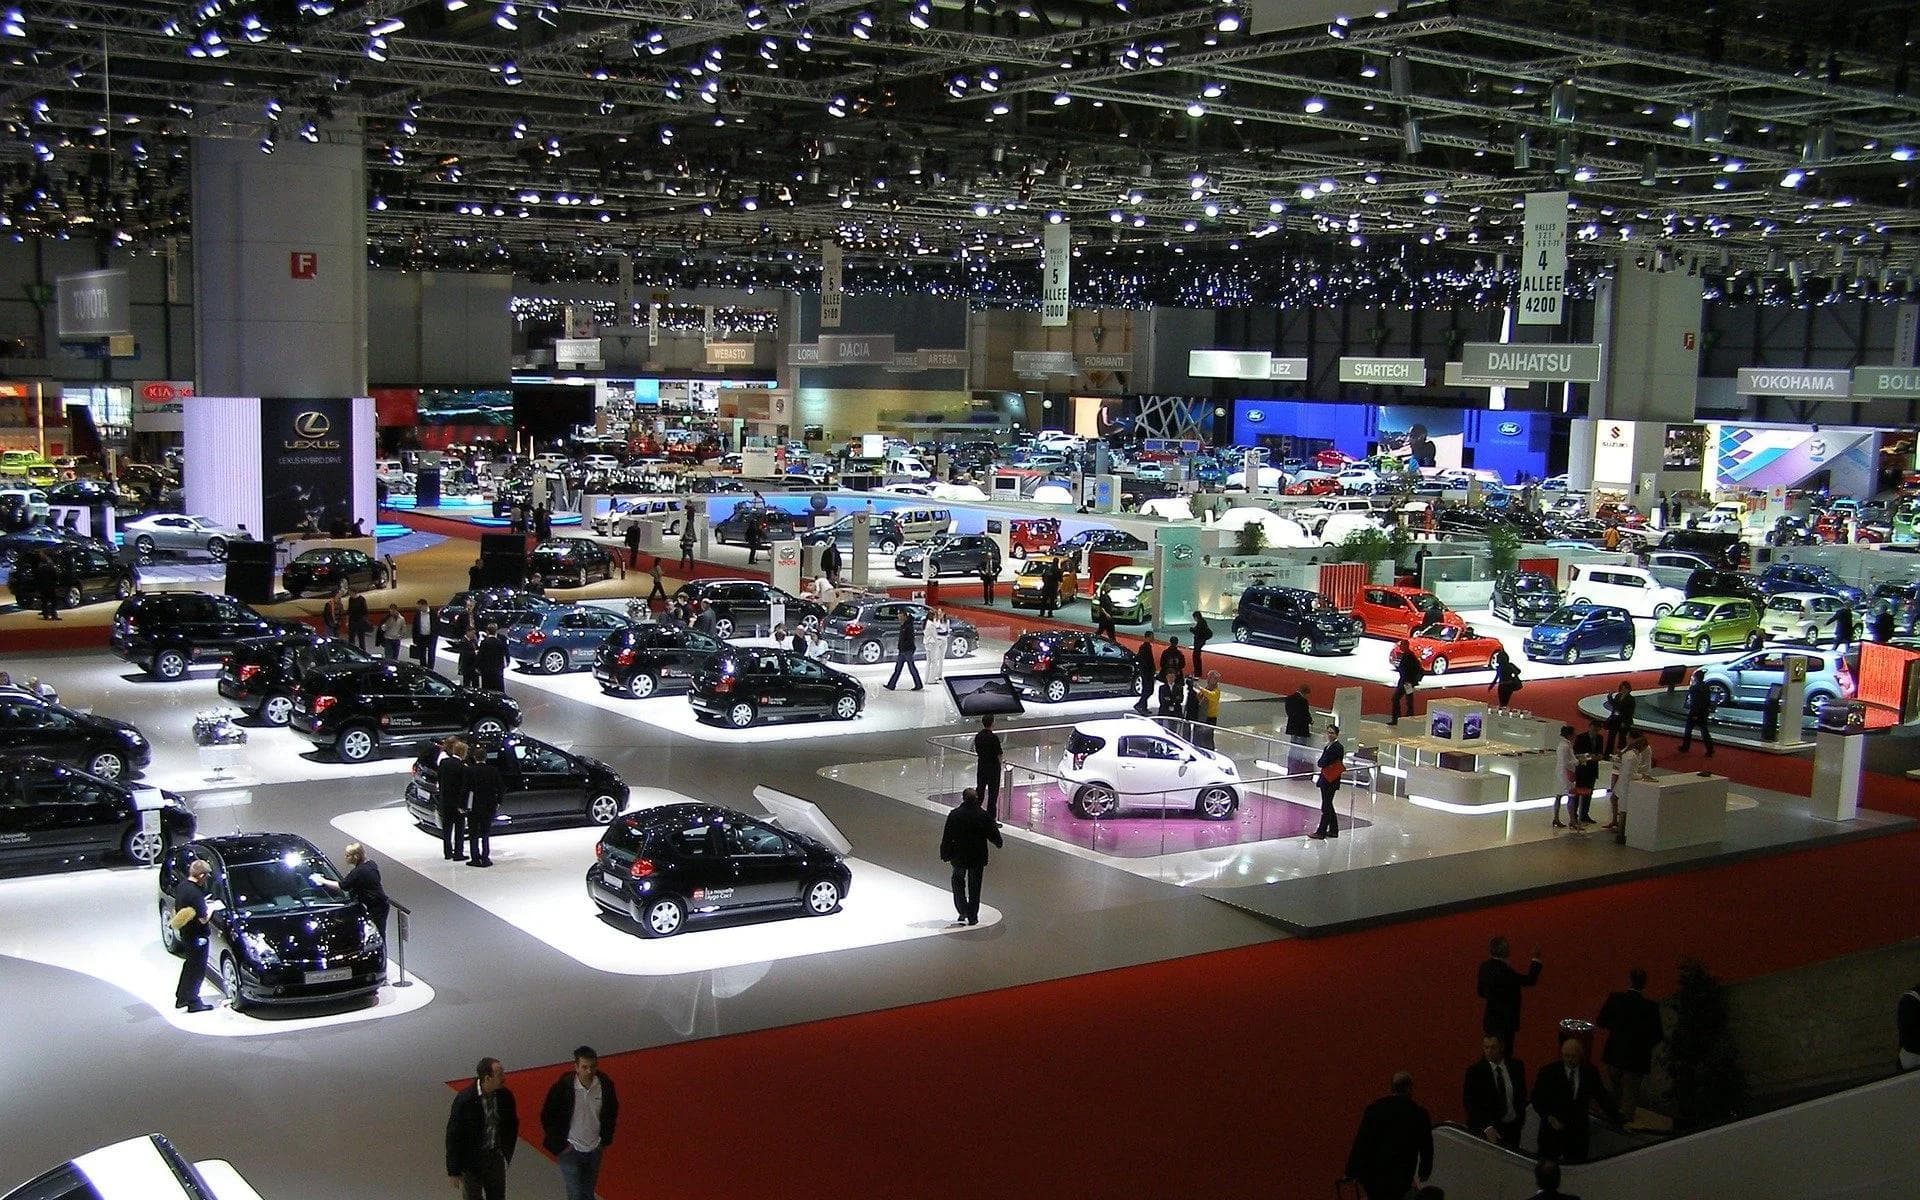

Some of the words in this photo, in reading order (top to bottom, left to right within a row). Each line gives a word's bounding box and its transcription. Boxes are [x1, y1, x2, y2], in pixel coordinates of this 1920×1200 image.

[1538, 250, 1548, 271] 4
[1052, 269, 1059, 285] 5
[1523, 276, 1562, 292] ALLEE
[1044, 288, 1067, 301] ALLEE
[1045, 305, 1064, 318] 5000
[1525, 297, 1556, 313] 4200
[714, 348, 746, 360] WEBASTO
[839, 342, 871, 358] DACIA
[1354, 363, 1409, 378] STARTECH
[1488, 352, 1572, 373] DAIHATSU
[1750, 375, 1835, 391] YOKOHAMA
[284, 440, 341, 449] LEXUS
